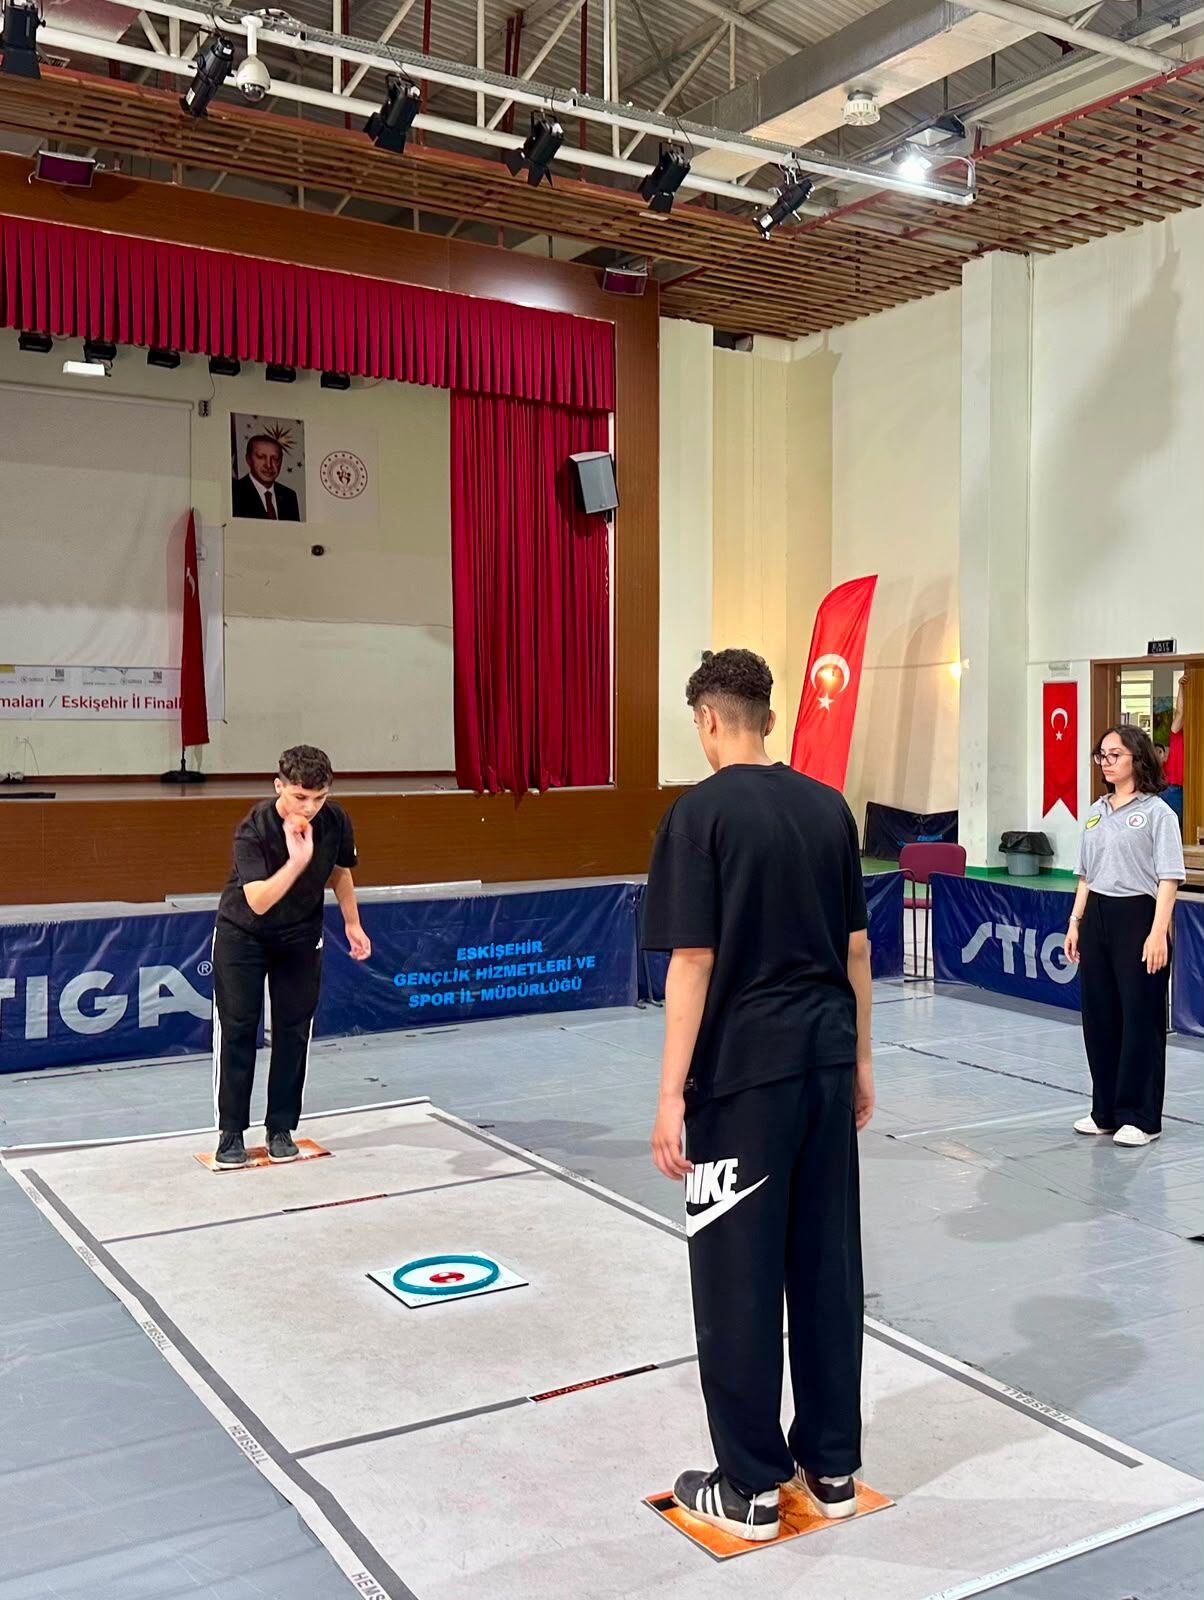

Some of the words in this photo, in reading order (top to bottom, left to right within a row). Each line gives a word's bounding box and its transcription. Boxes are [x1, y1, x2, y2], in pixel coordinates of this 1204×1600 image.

[0, 694, 44, 708] maları
[48, 695, 57, 708] /
[62, 695, 128, 711] Eskişehir
[132, 692, 140, 709] İl
[456, 939, 543, 961] ESKİŞEHİR
[961, 921, 1079, 984] STIG
[393, 967, 470, 987] GENÇLİK
[475, 955, 571, 981] HİZMETLERİ
[576, 955, 596, 969] VE
[408, 992, 455, 1008] SPOR
[460, 987, 475, 1004] İL
[480, 976, 583, 1001] MÜDÜRLÜĞÜ
[1002, 1385, 1071, 1422] HEMSBALL
[227, 1424, 269, 1464] HEMSBALL
